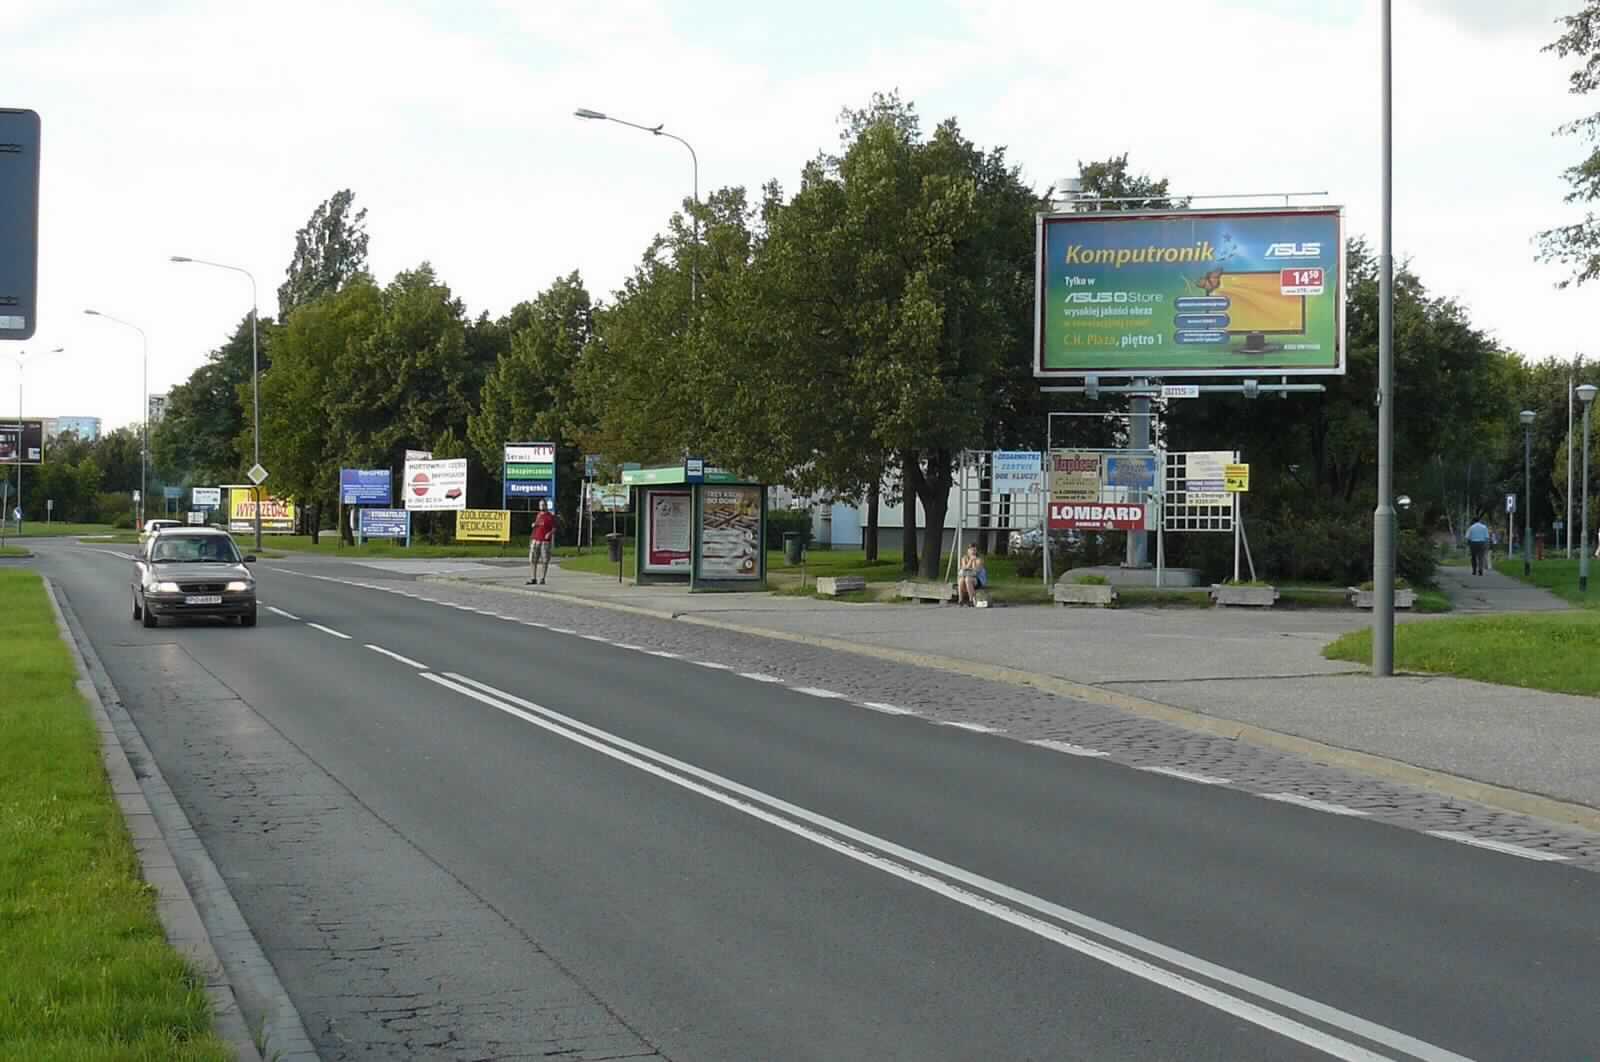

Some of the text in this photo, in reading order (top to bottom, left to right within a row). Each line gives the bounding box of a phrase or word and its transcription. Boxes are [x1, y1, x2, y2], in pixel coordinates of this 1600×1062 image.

[1066, 241, 1215, 268] Komputronik
[1264, 242, 1321, 257] ASUS
[1065, 276, 1086, 288] Tylko
[1121, 334, 1154, 348] piętro
[1051, 506, 1142, 521] LOMBARD
